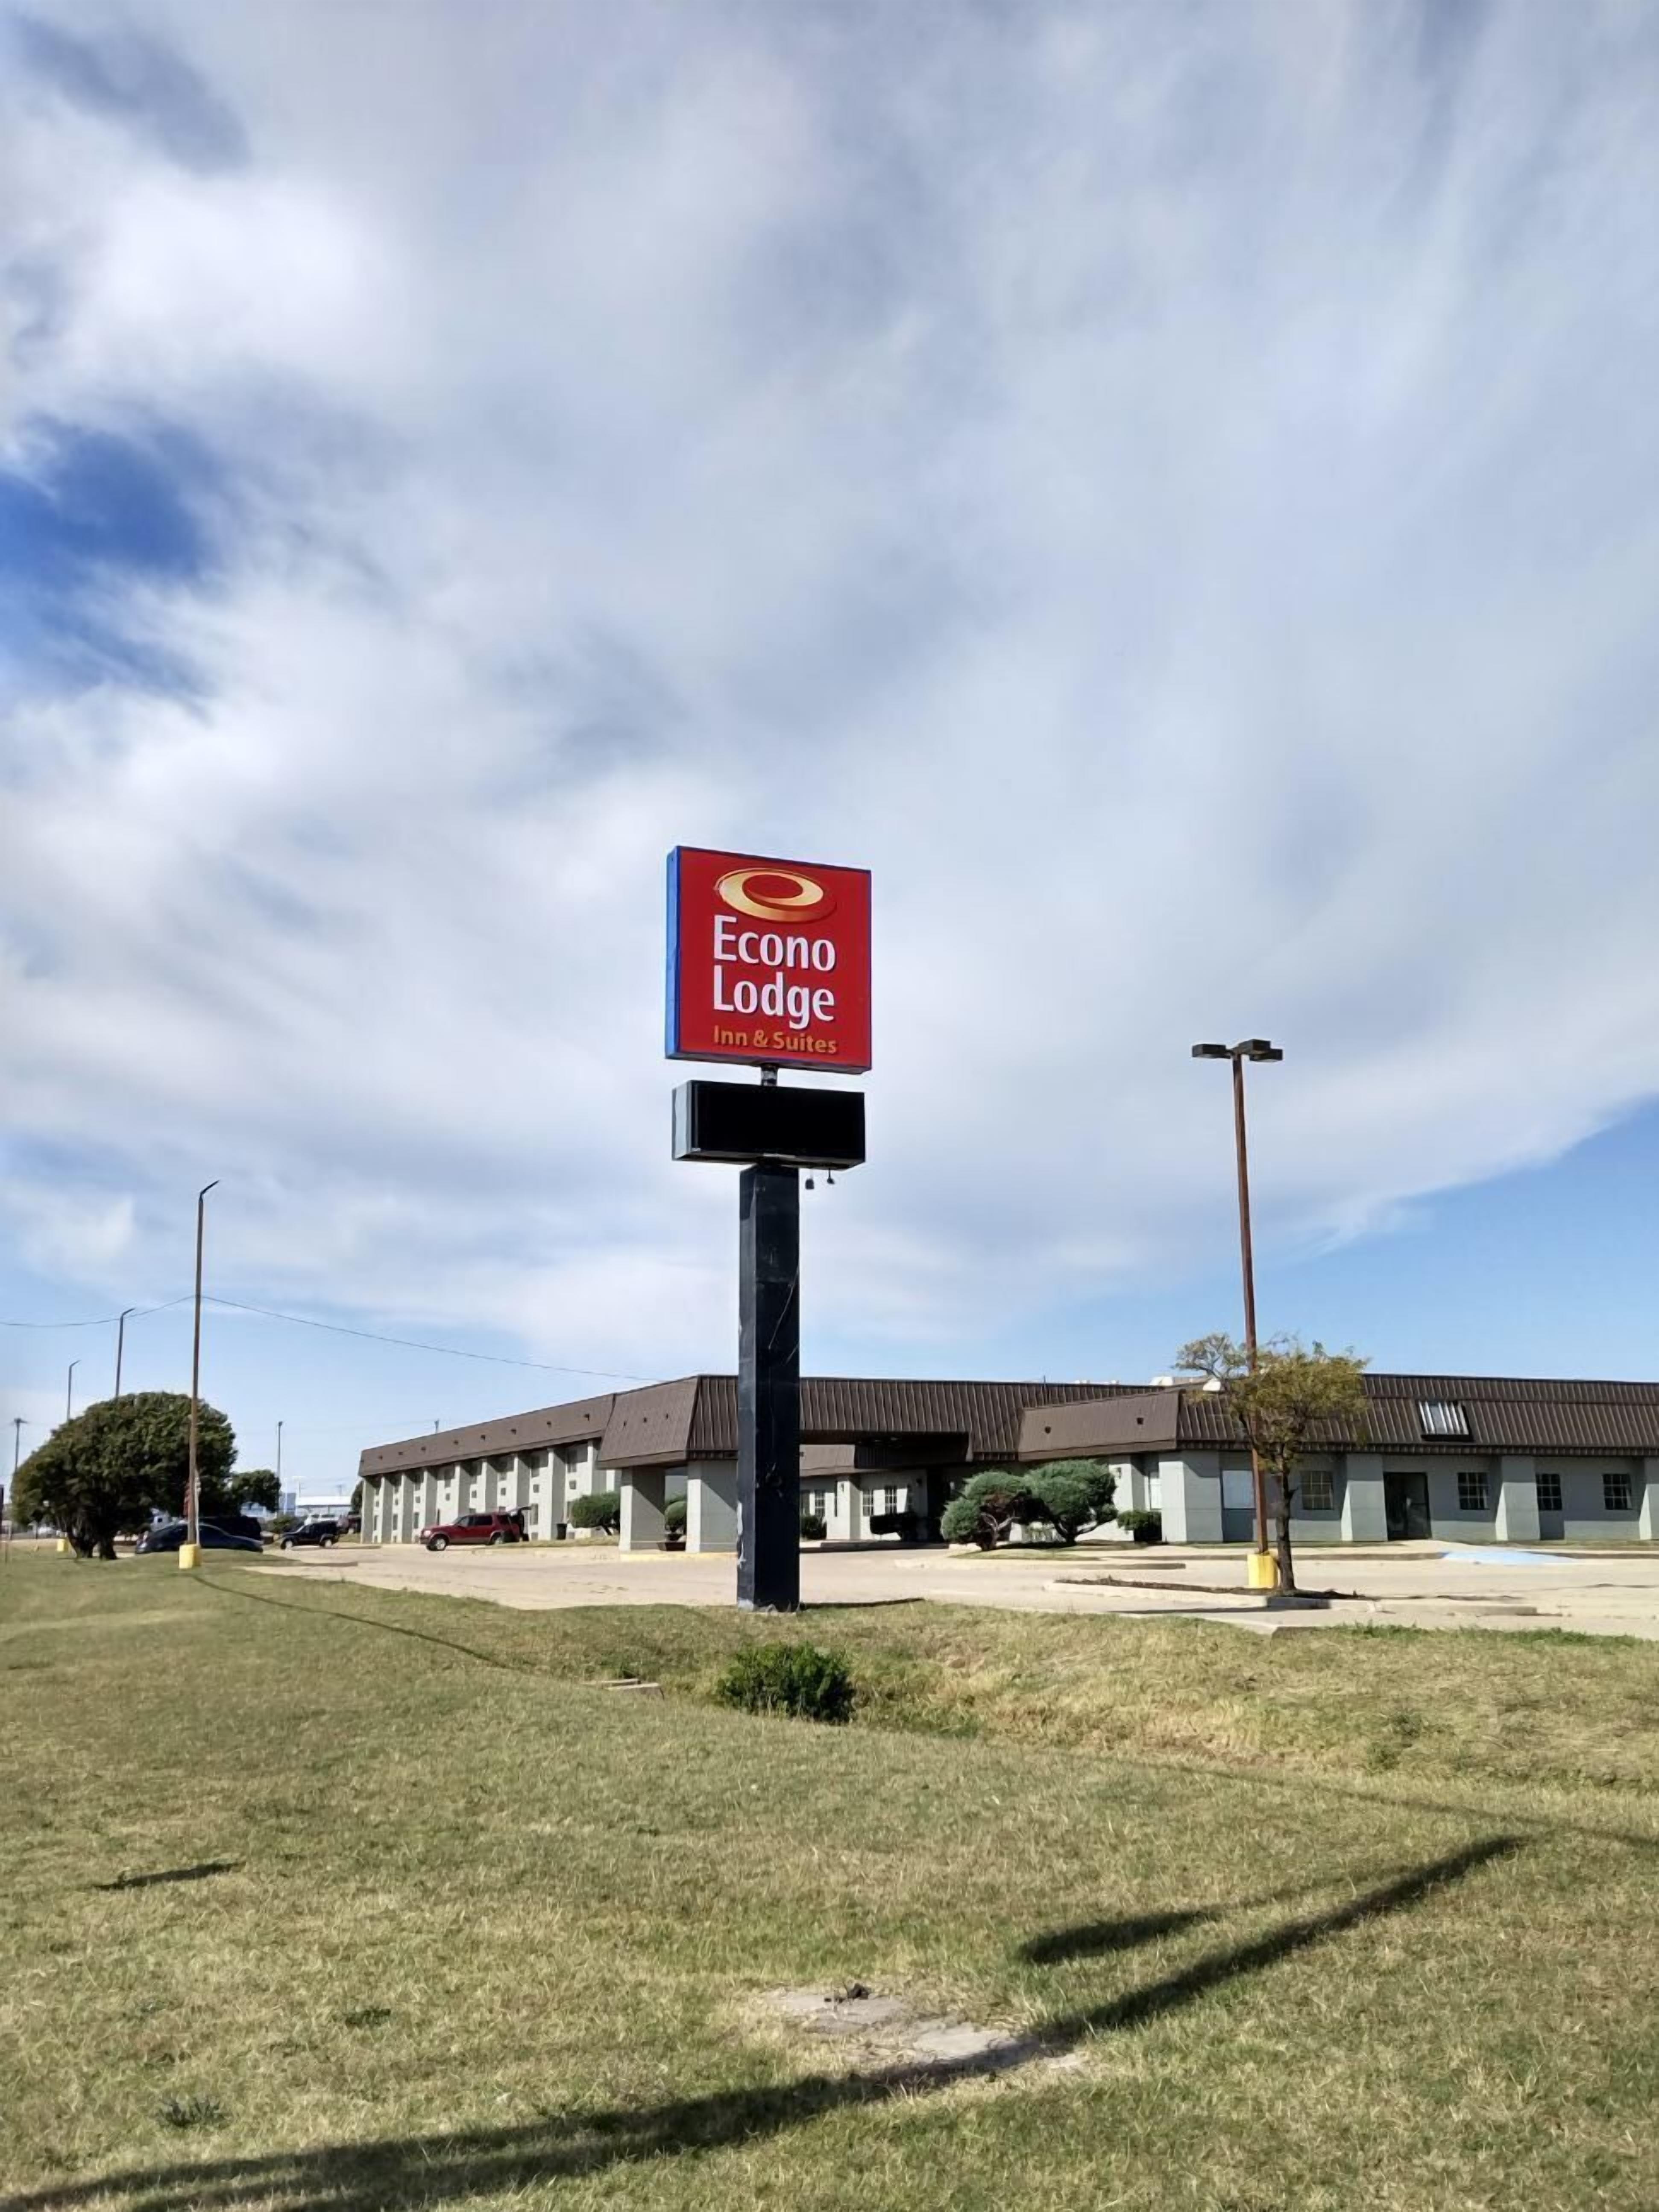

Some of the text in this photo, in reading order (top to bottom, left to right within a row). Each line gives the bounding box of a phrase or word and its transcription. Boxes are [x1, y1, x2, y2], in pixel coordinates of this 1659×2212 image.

[713, 915, 836, 971] Econo
[713, 965, 835, 1029] Lodge
[714, 1026, 837, 1054] Inn & Suites
